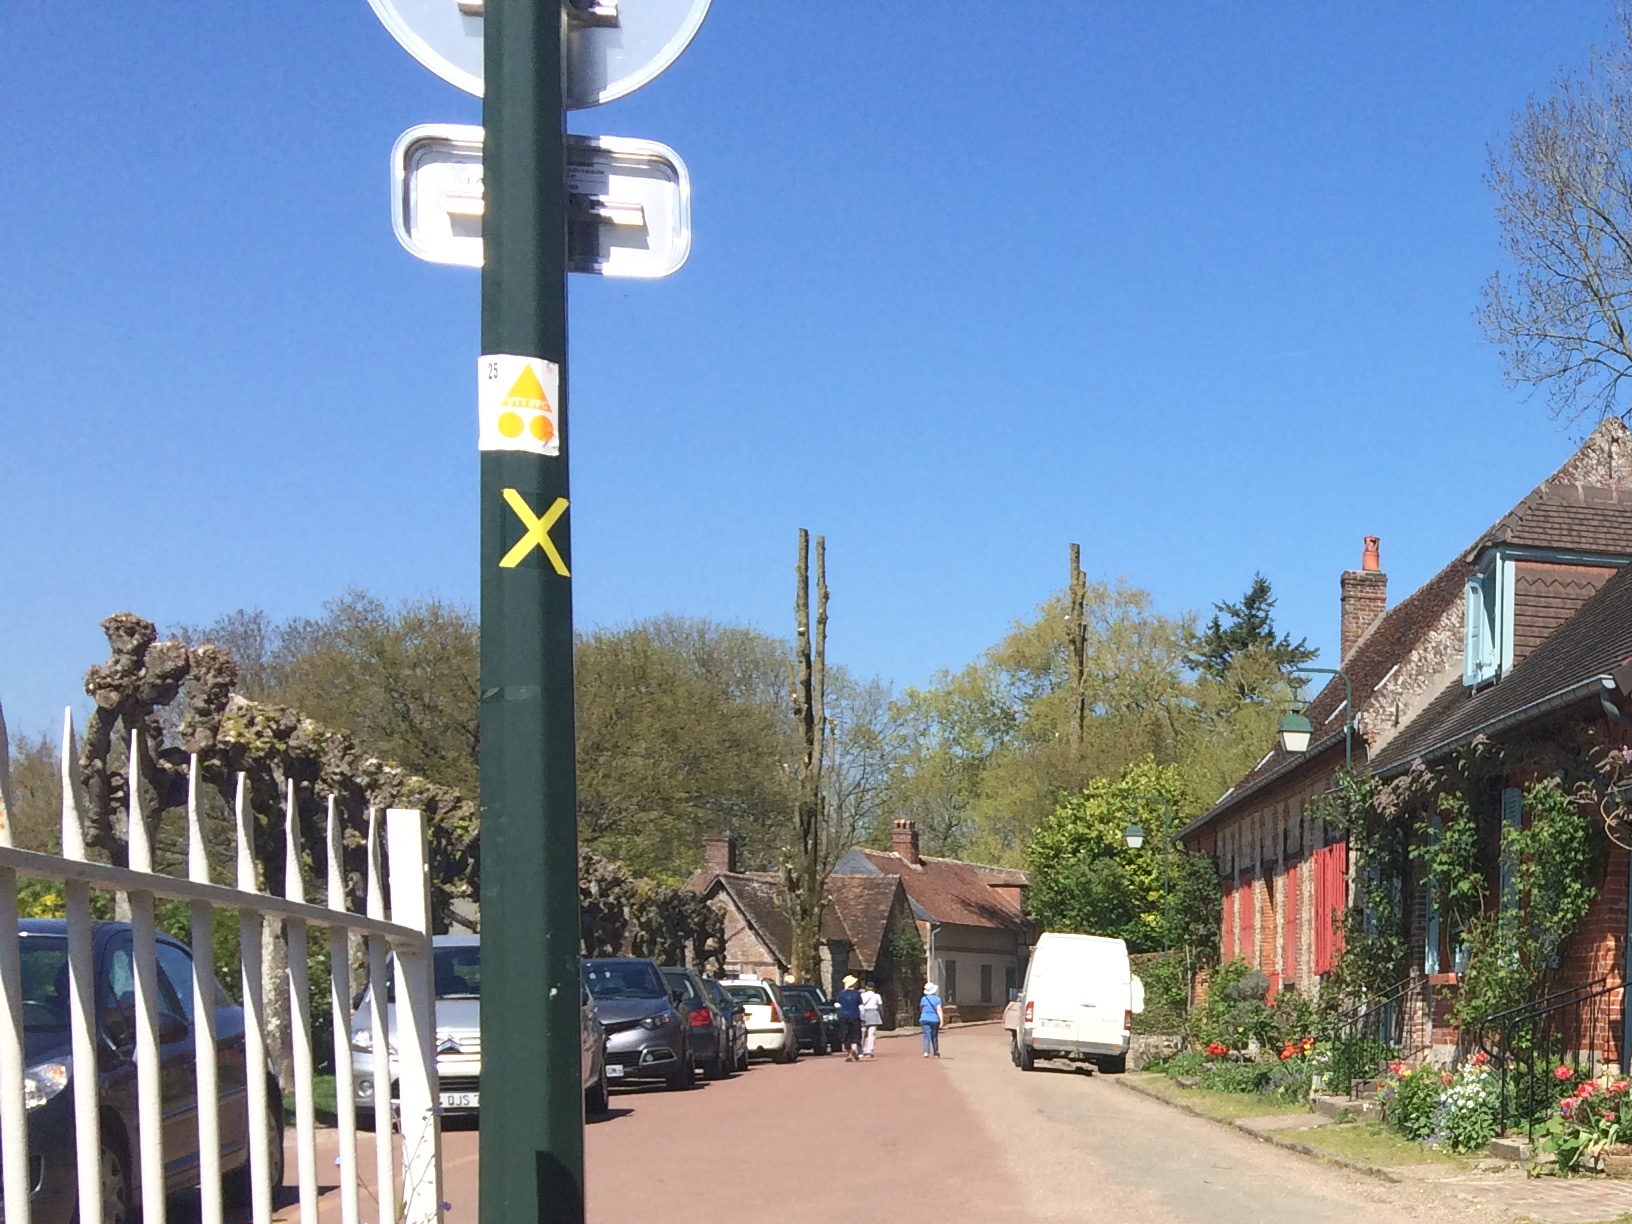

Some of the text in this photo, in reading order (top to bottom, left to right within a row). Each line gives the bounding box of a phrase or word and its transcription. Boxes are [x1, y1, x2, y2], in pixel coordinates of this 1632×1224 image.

[488, 362, 498, 379] 25
[506, 396, 548, 410] VTT FFC
